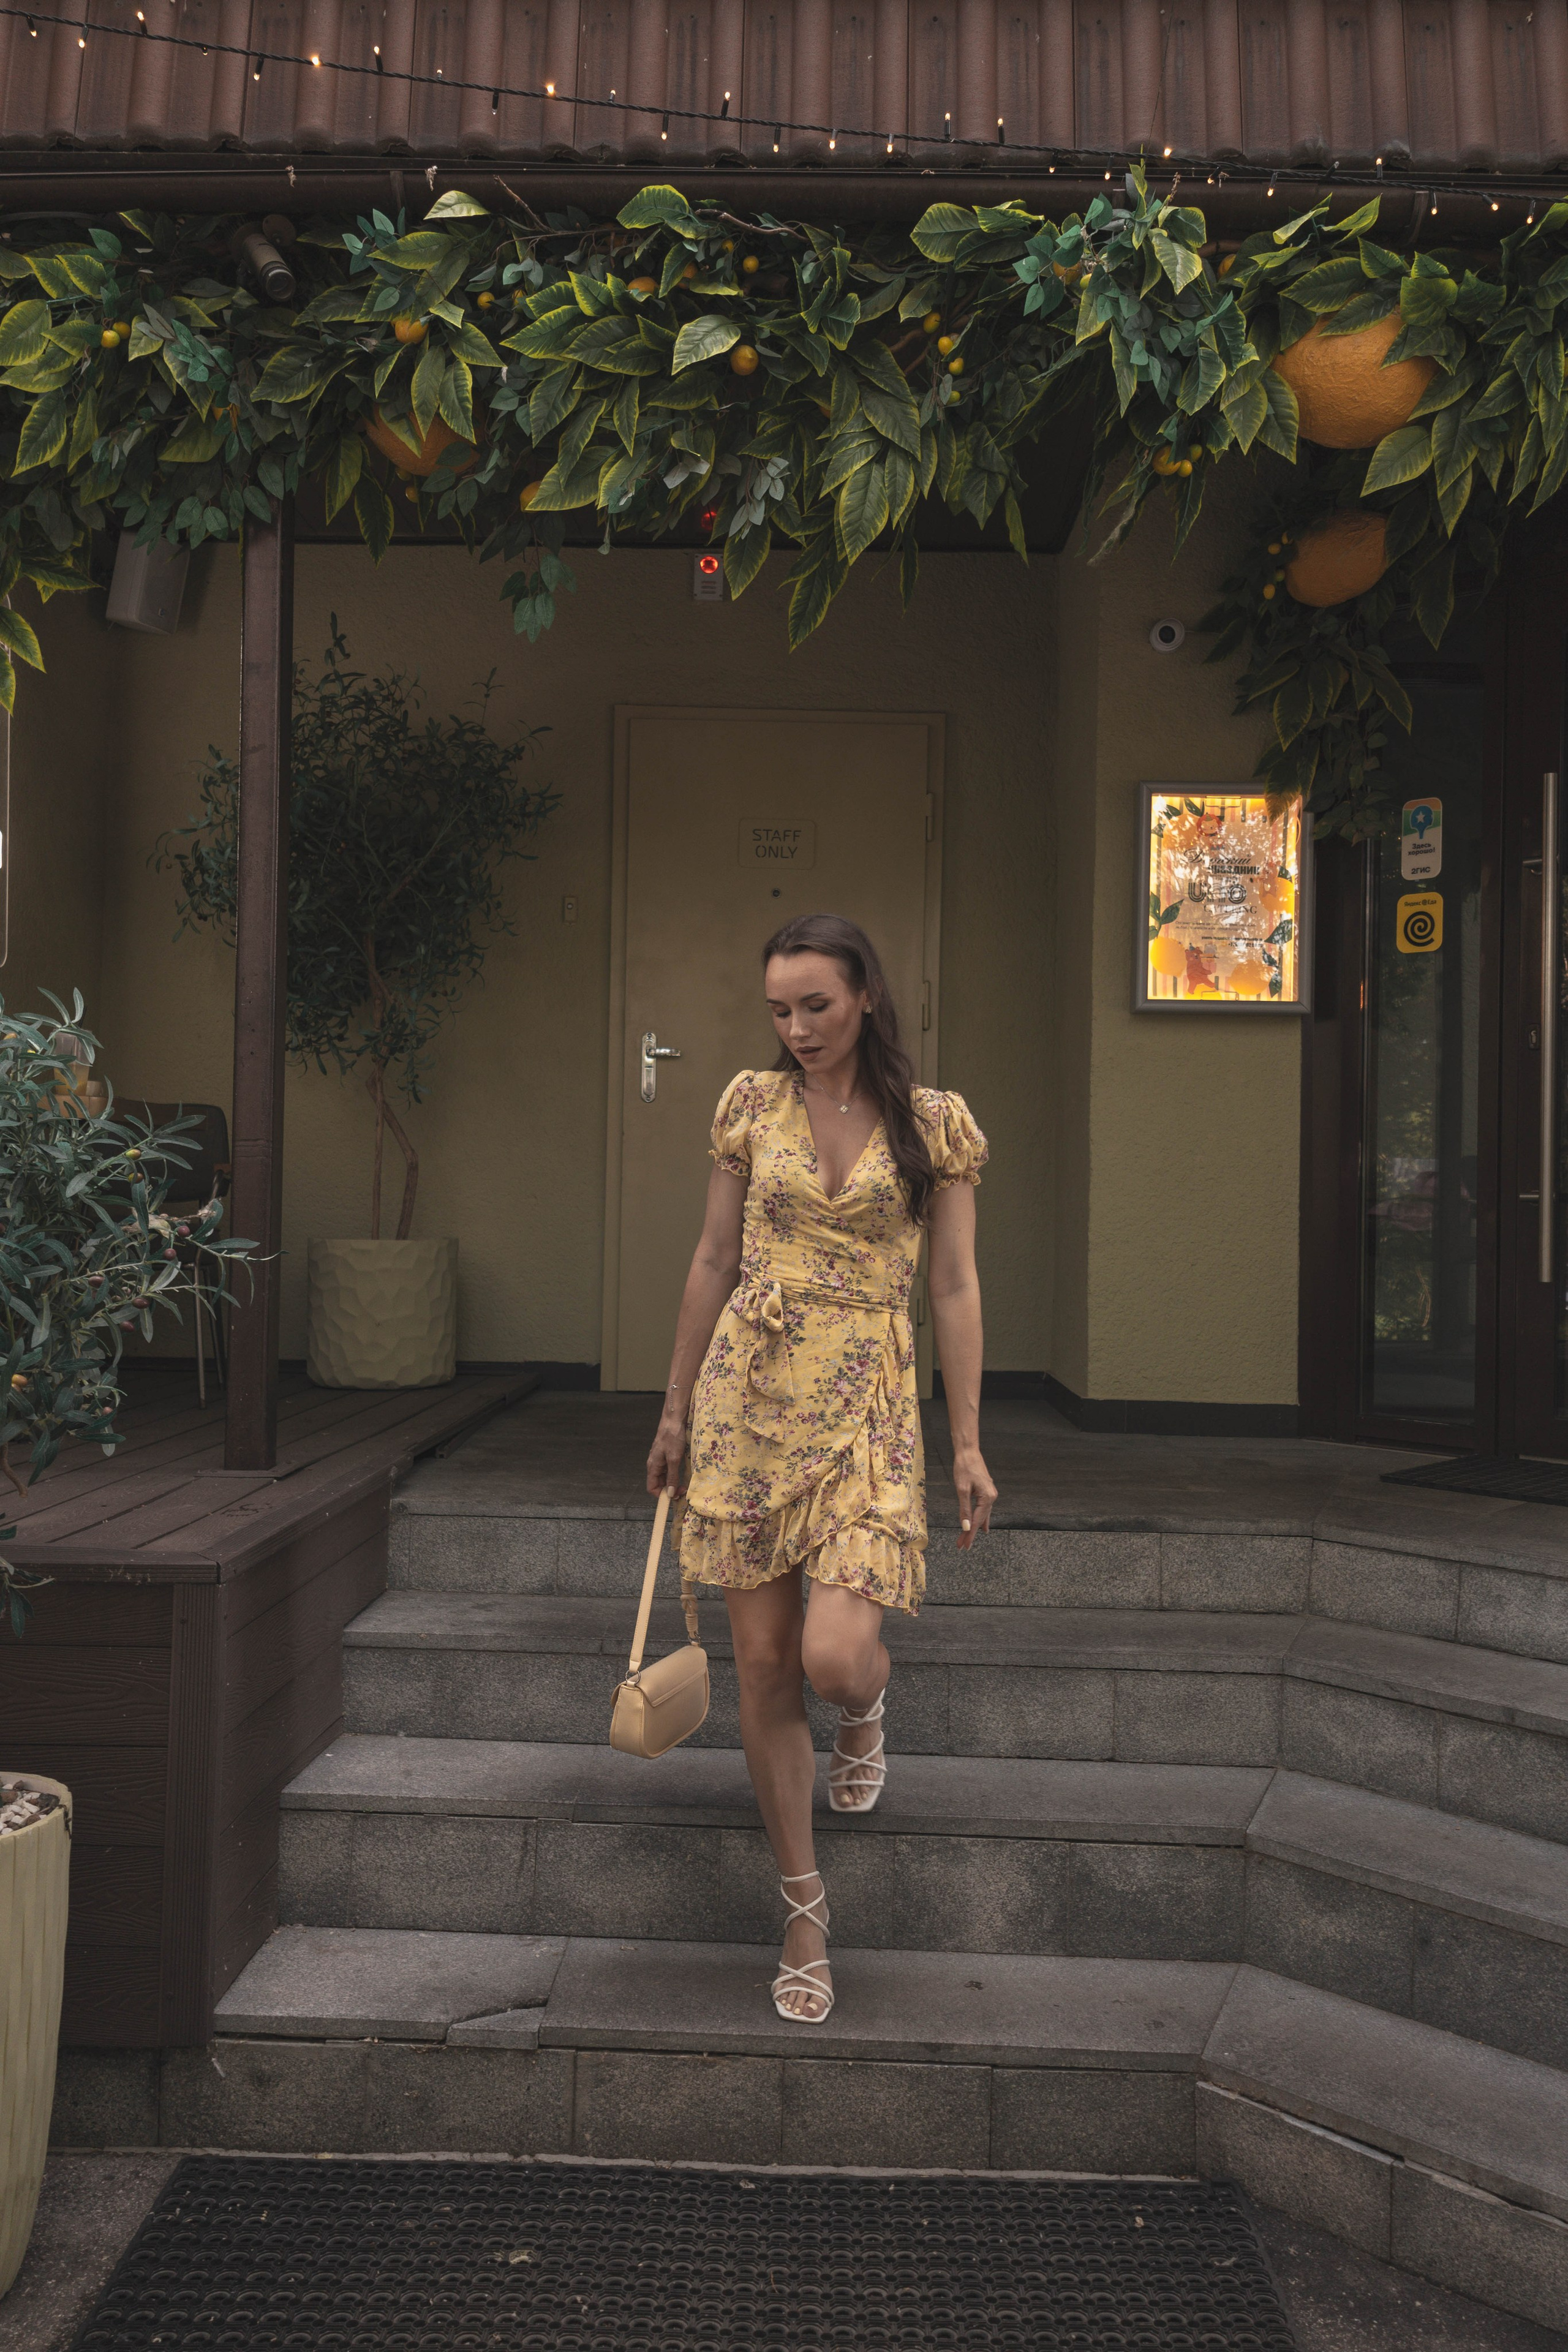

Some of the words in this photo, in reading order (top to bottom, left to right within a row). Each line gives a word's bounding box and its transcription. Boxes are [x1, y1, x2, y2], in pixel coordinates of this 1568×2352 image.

[752, 829, 802, 842] STAFF
[755, 845, 797, 859] ONLY
[1408, 847, 1436, 856] хорошо!
